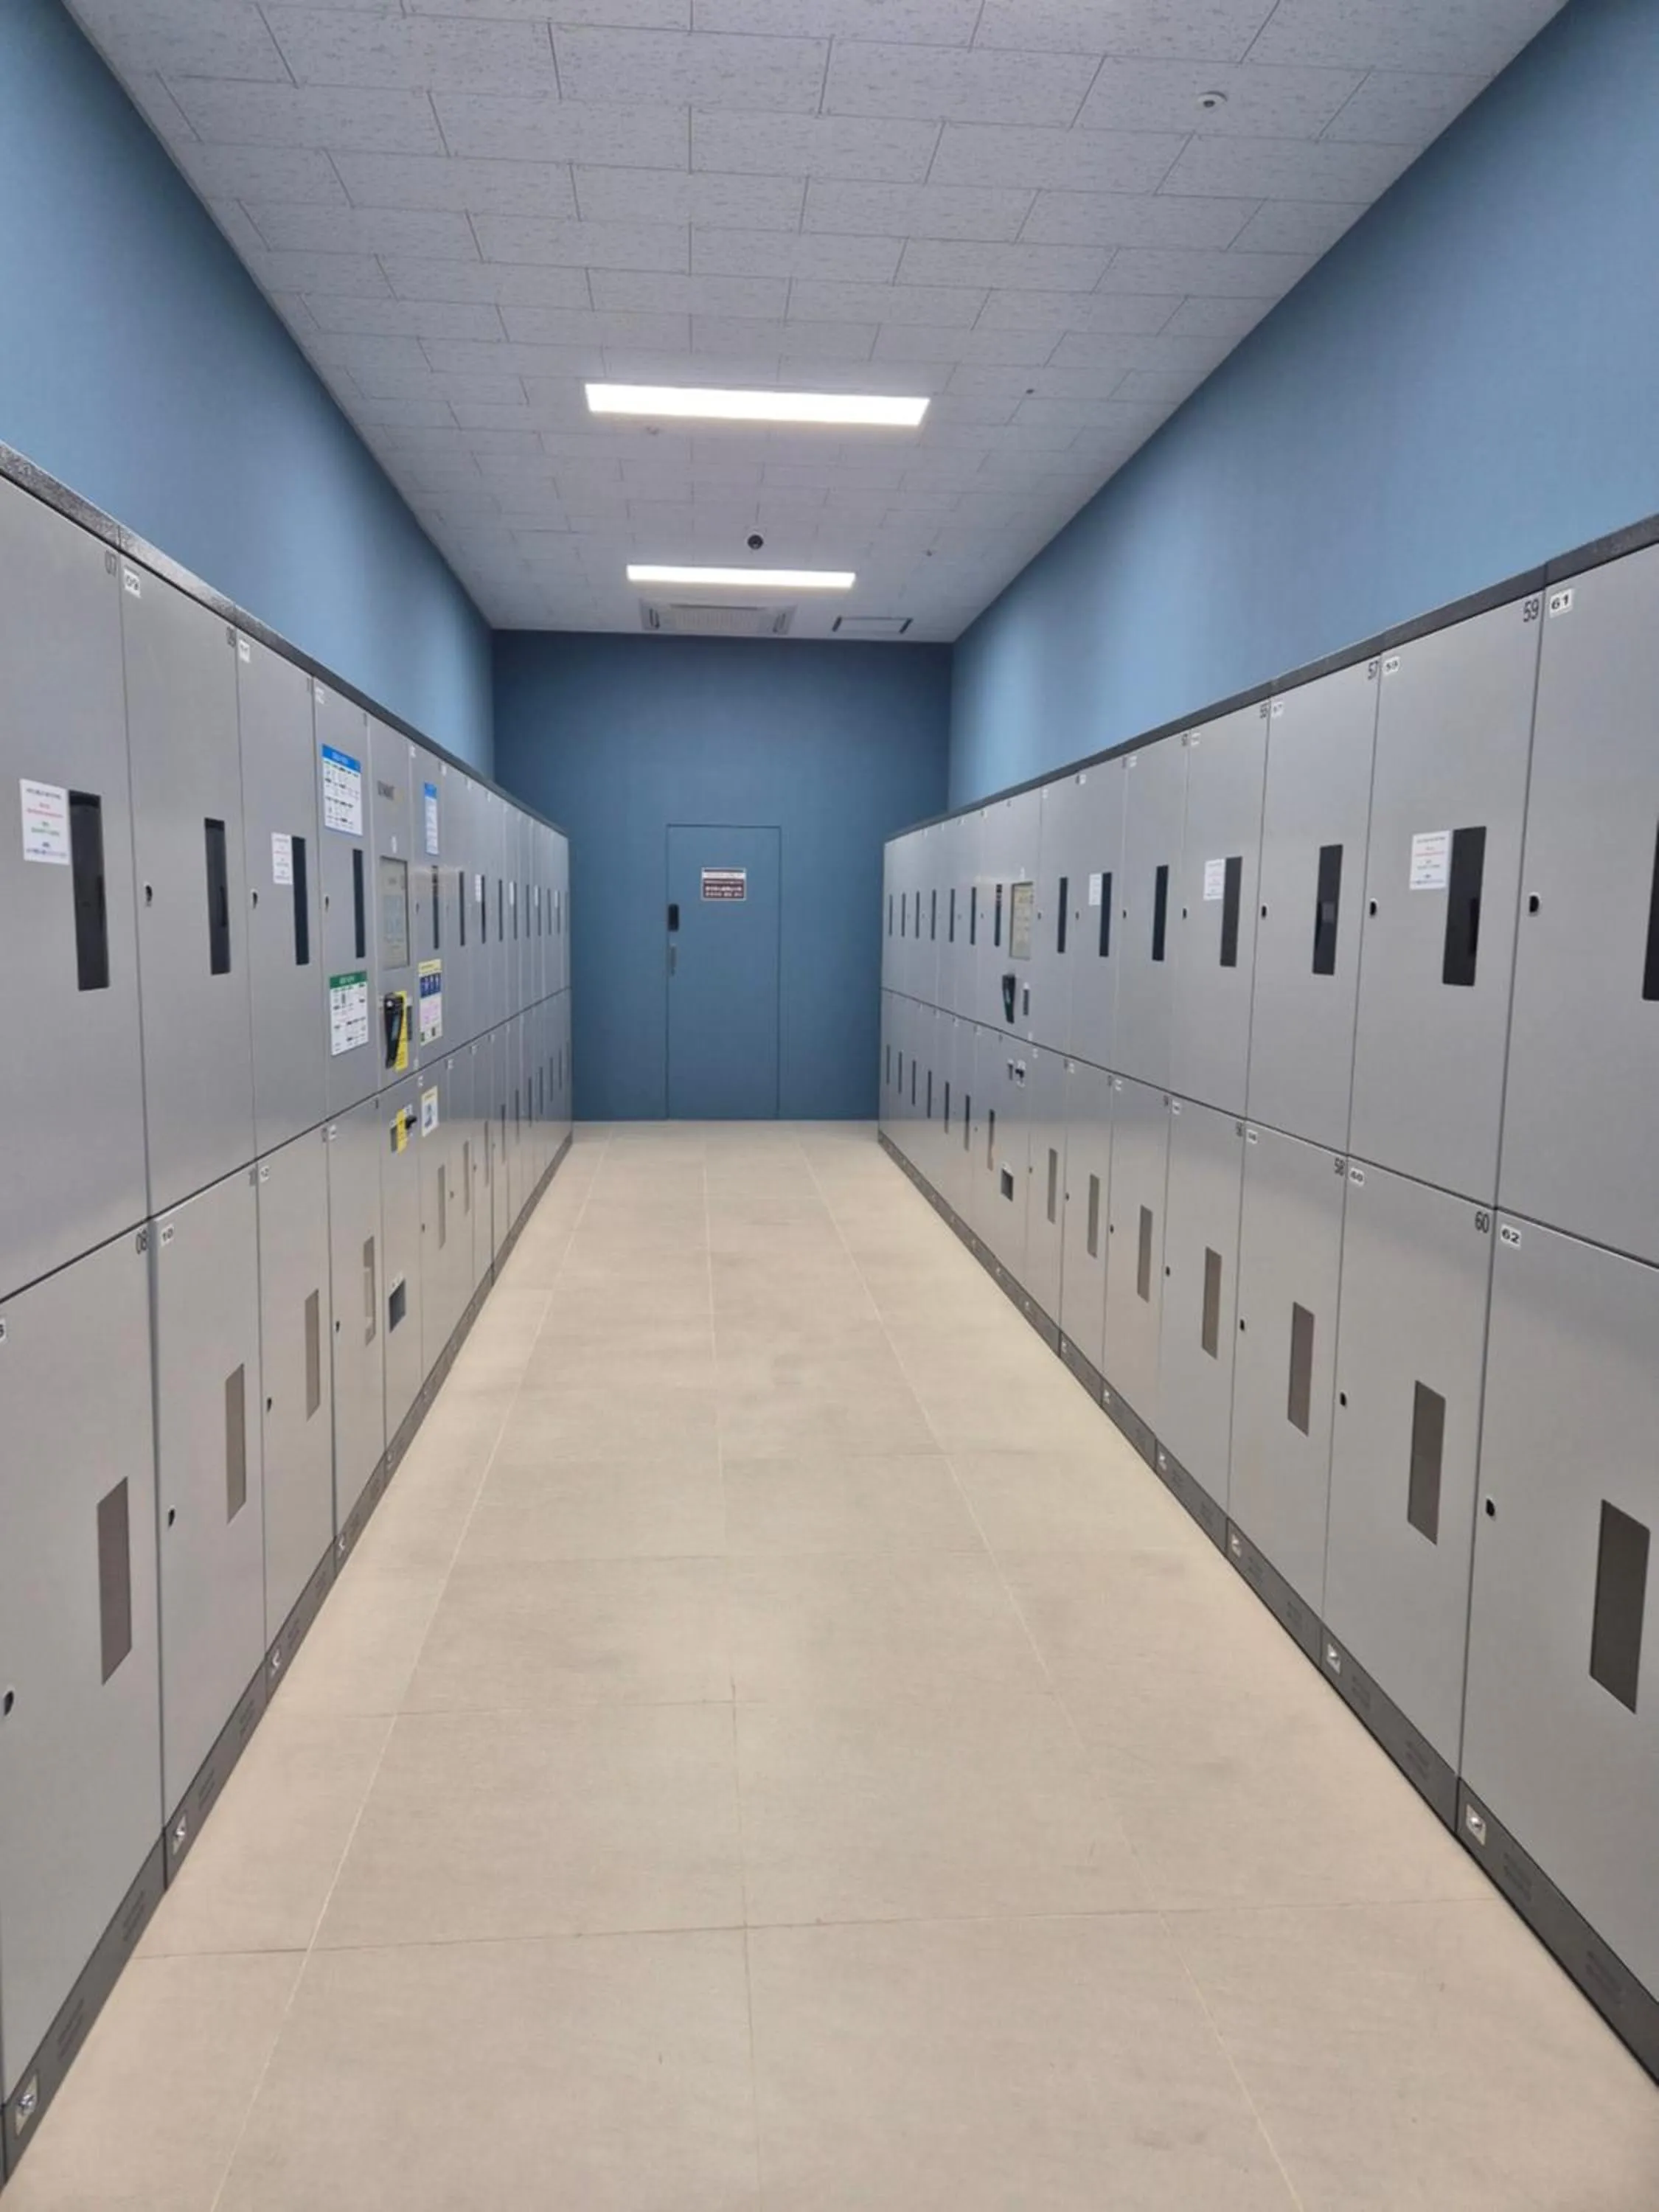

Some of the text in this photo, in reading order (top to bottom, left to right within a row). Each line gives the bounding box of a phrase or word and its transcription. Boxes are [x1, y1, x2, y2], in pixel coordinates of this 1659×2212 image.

[1523, 598, 1539, 622] 59
[1551, 594, 1568, 610] 61
[1475, 1211, 1489, 1234] 60
[1502, 1228, 1520, 1244] 62
